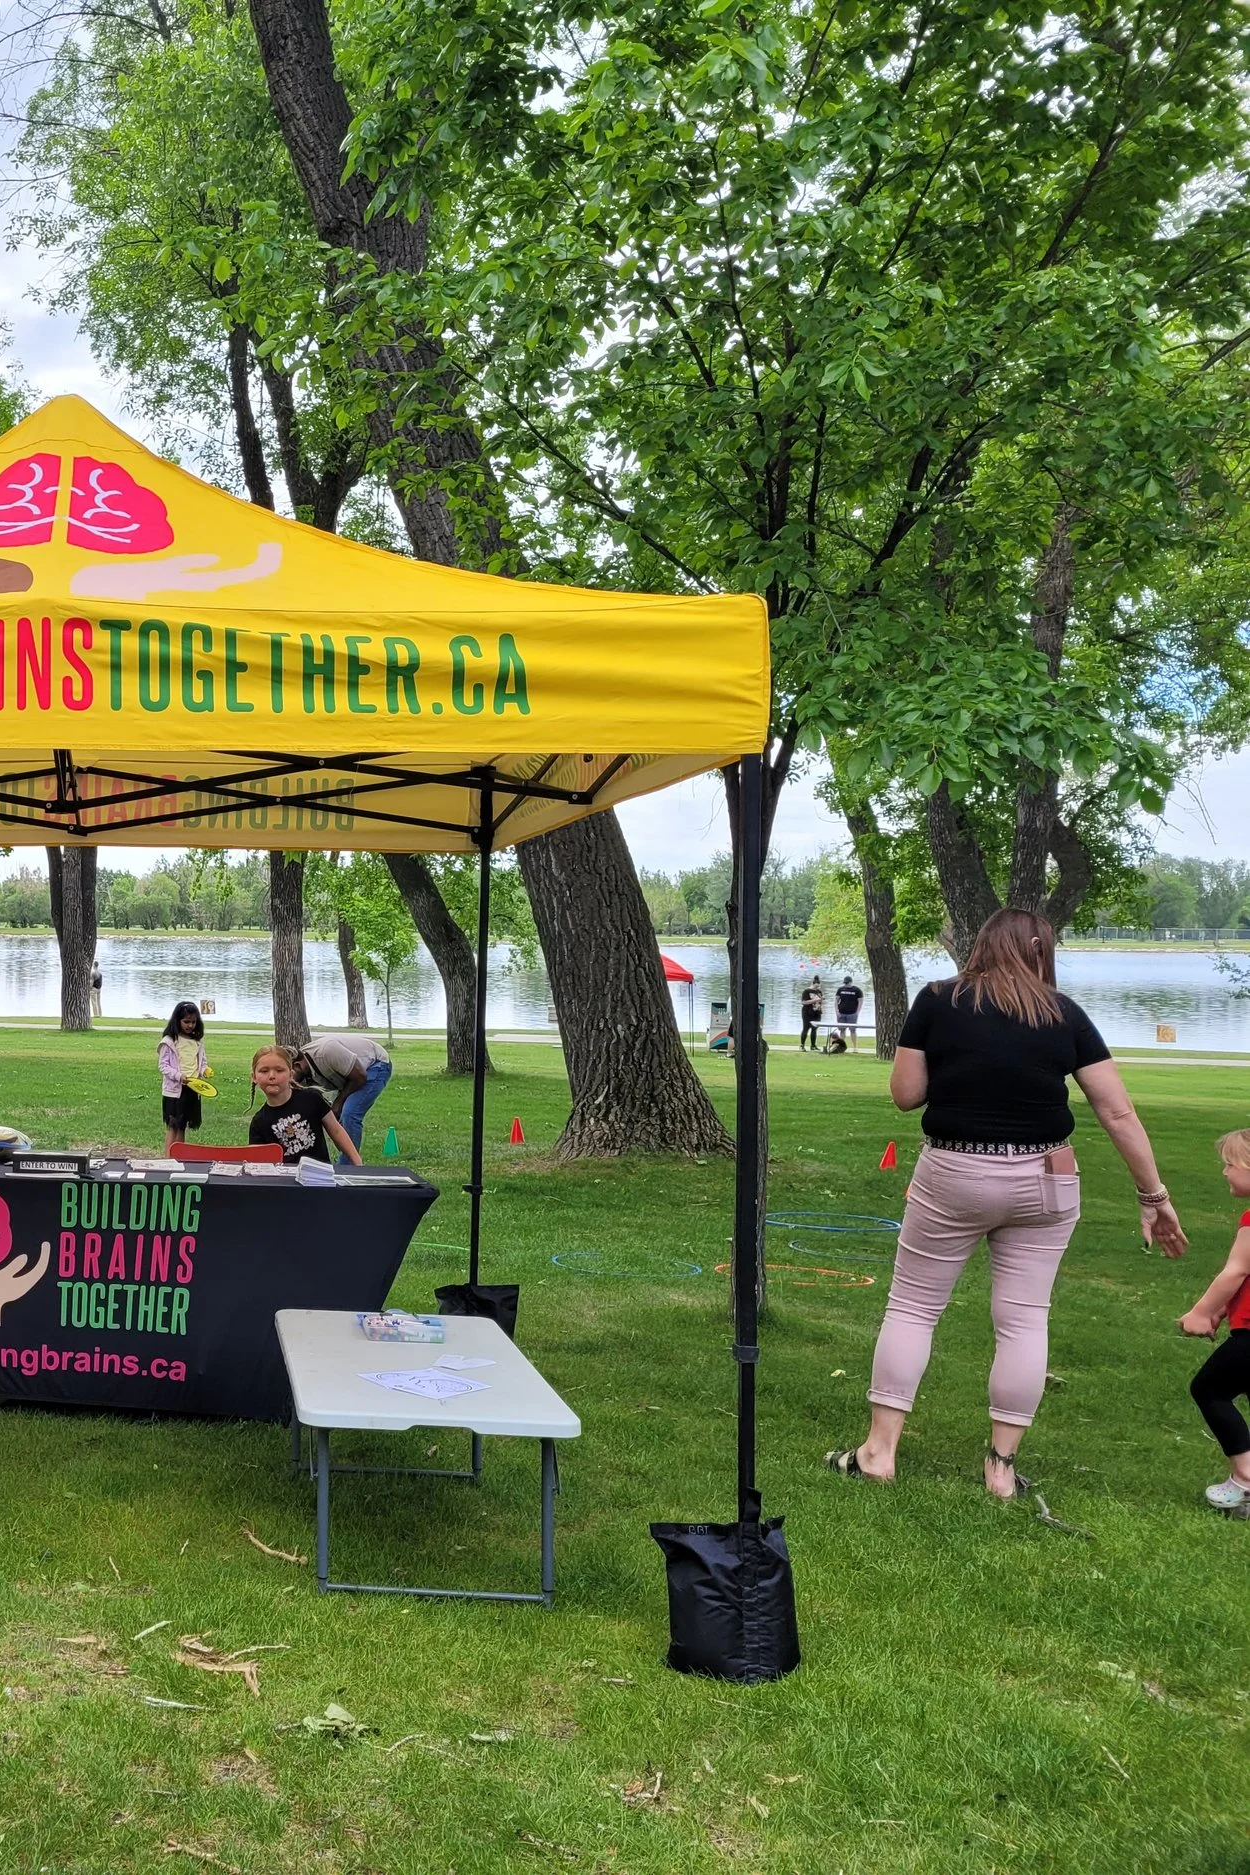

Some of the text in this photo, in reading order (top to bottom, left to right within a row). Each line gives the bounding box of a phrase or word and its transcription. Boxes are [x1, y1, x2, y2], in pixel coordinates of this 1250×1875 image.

[21, 1161, 44, 1169] ENTER
[57, 1163, 77, 1171] WIN!
[60, 1182, 202, 1233] BUILDING
[57, 1232, 196, 1284] BRAINS
[57, 1281, 190, 1335] TOGETHER
